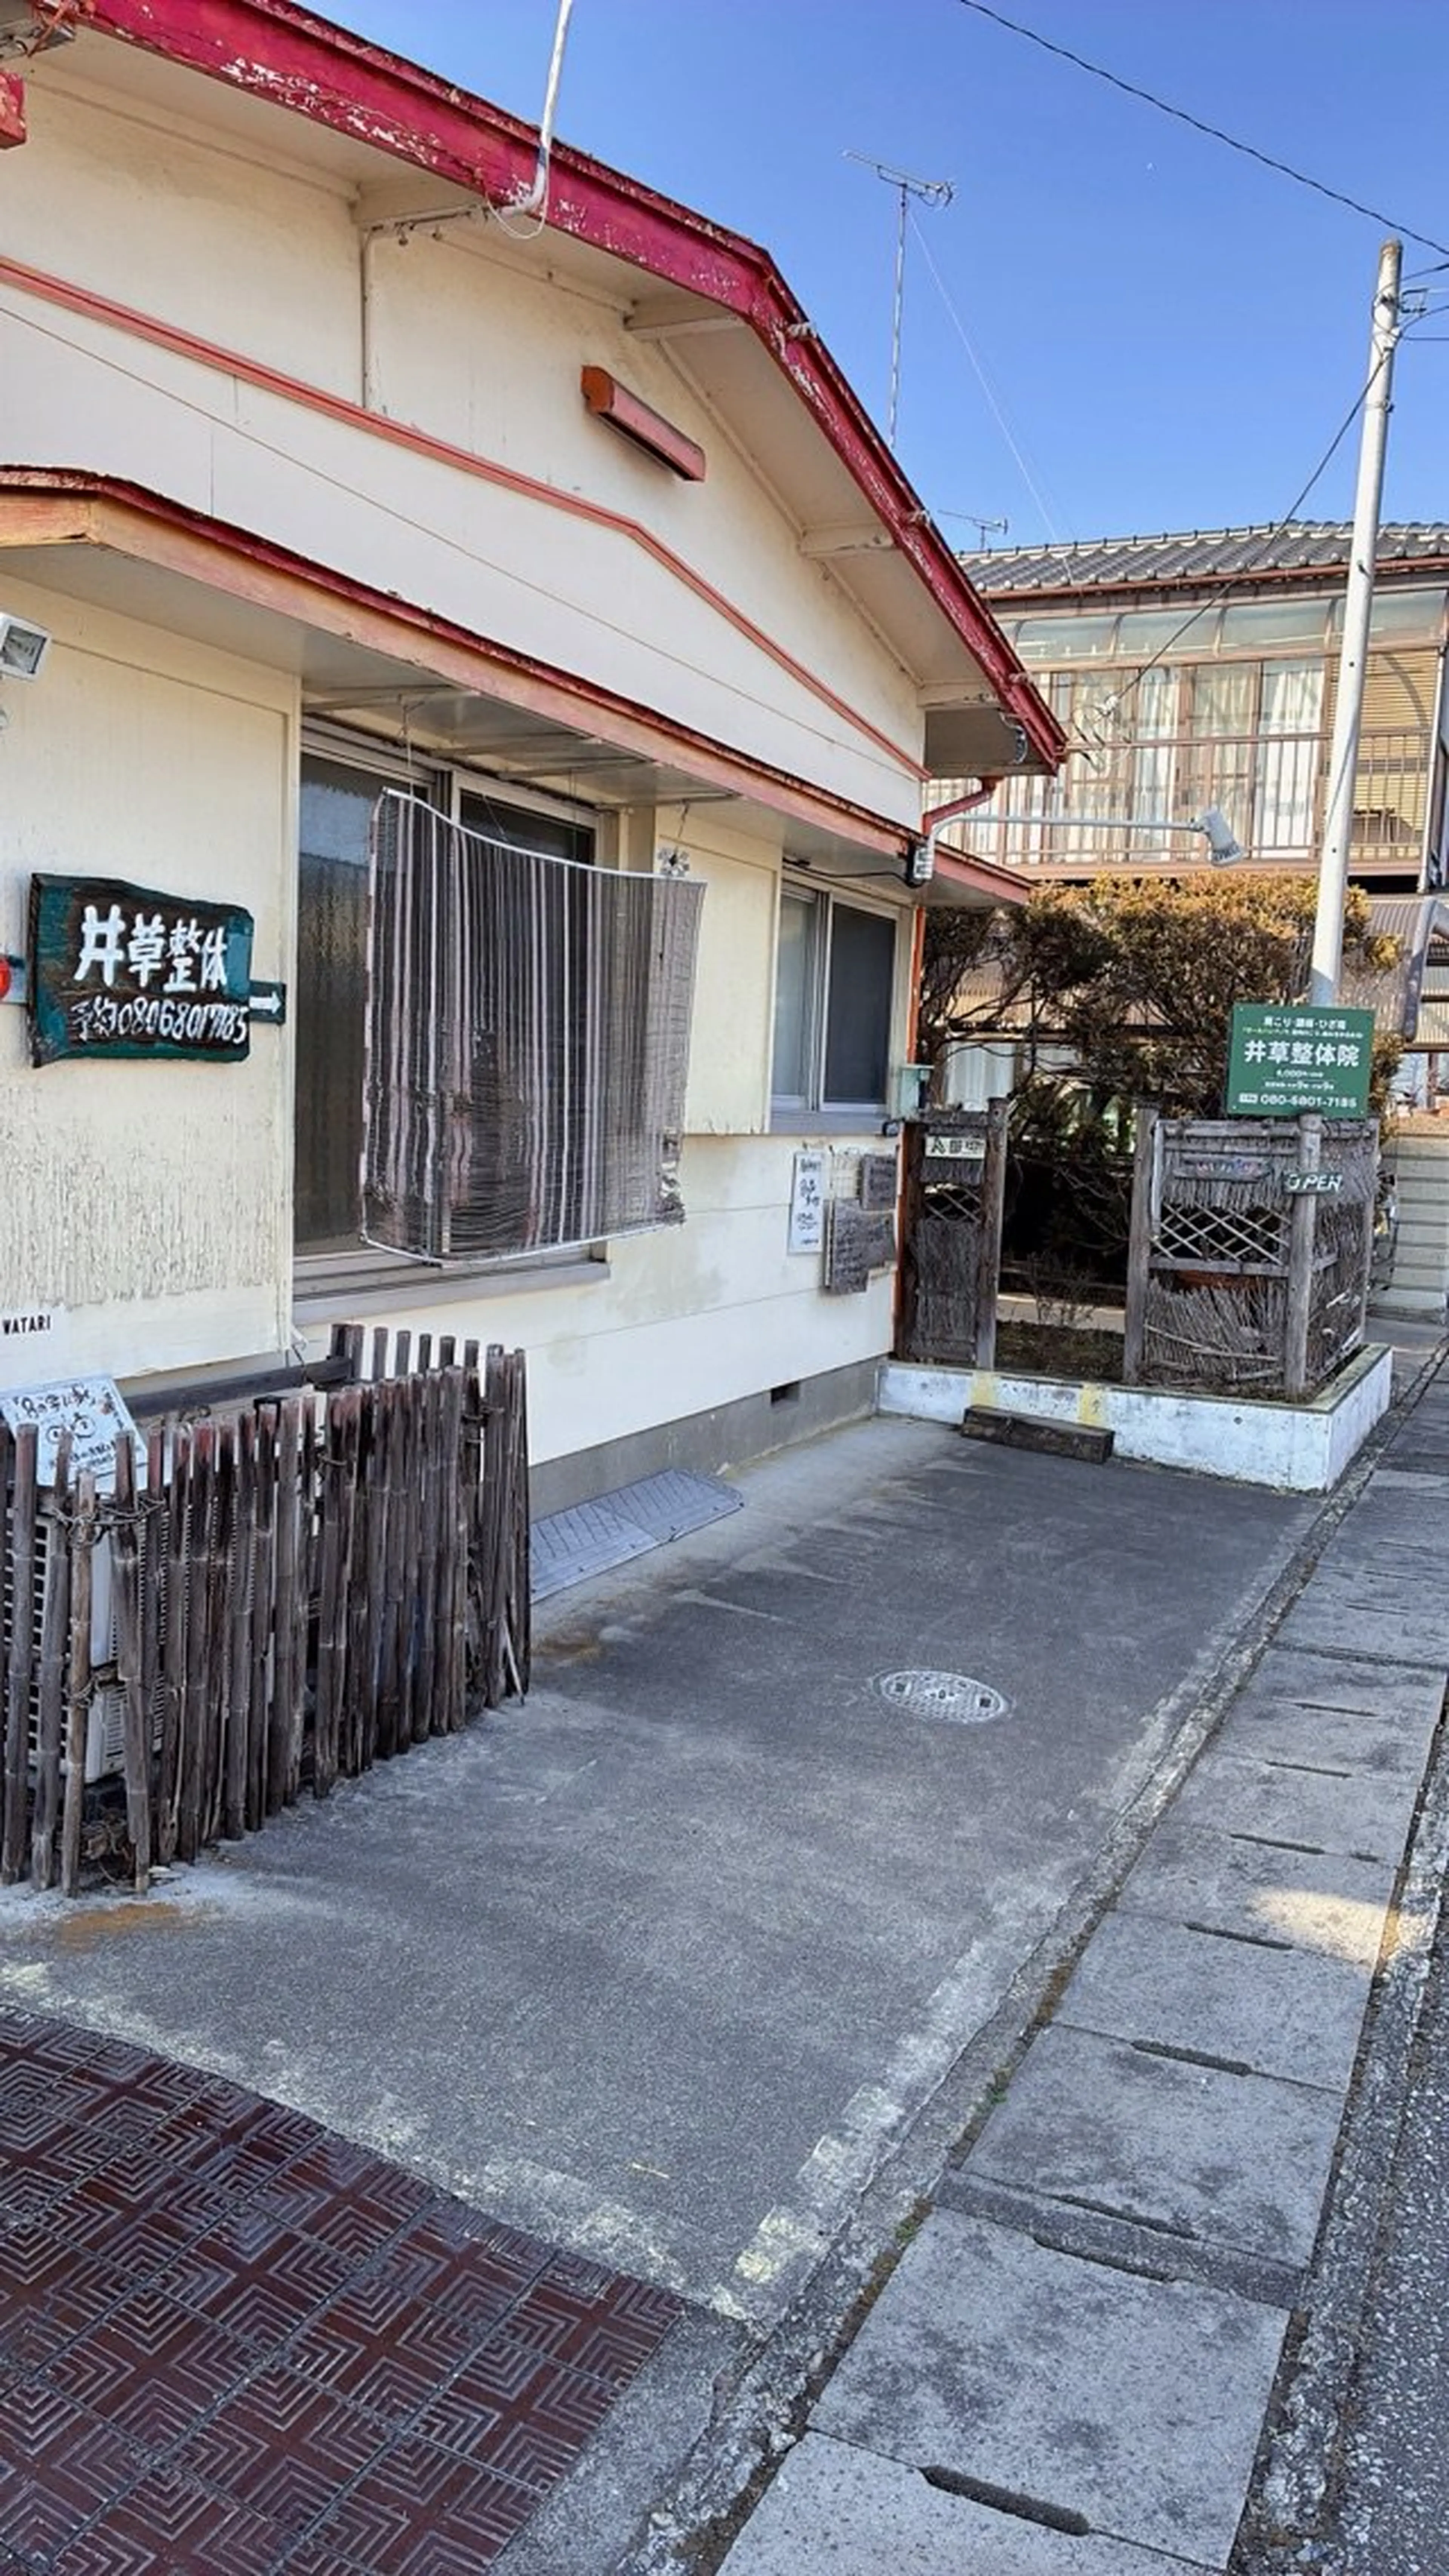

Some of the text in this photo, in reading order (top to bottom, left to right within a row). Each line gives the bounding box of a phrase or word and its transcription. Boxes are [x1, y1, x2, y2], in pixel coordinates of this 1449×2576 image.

[74, 904, 228, 993] 井草整体
[1244, 1040, 1360, 1067] 井草整体院
[1288, 1173, 1343, 1192] OPEN
